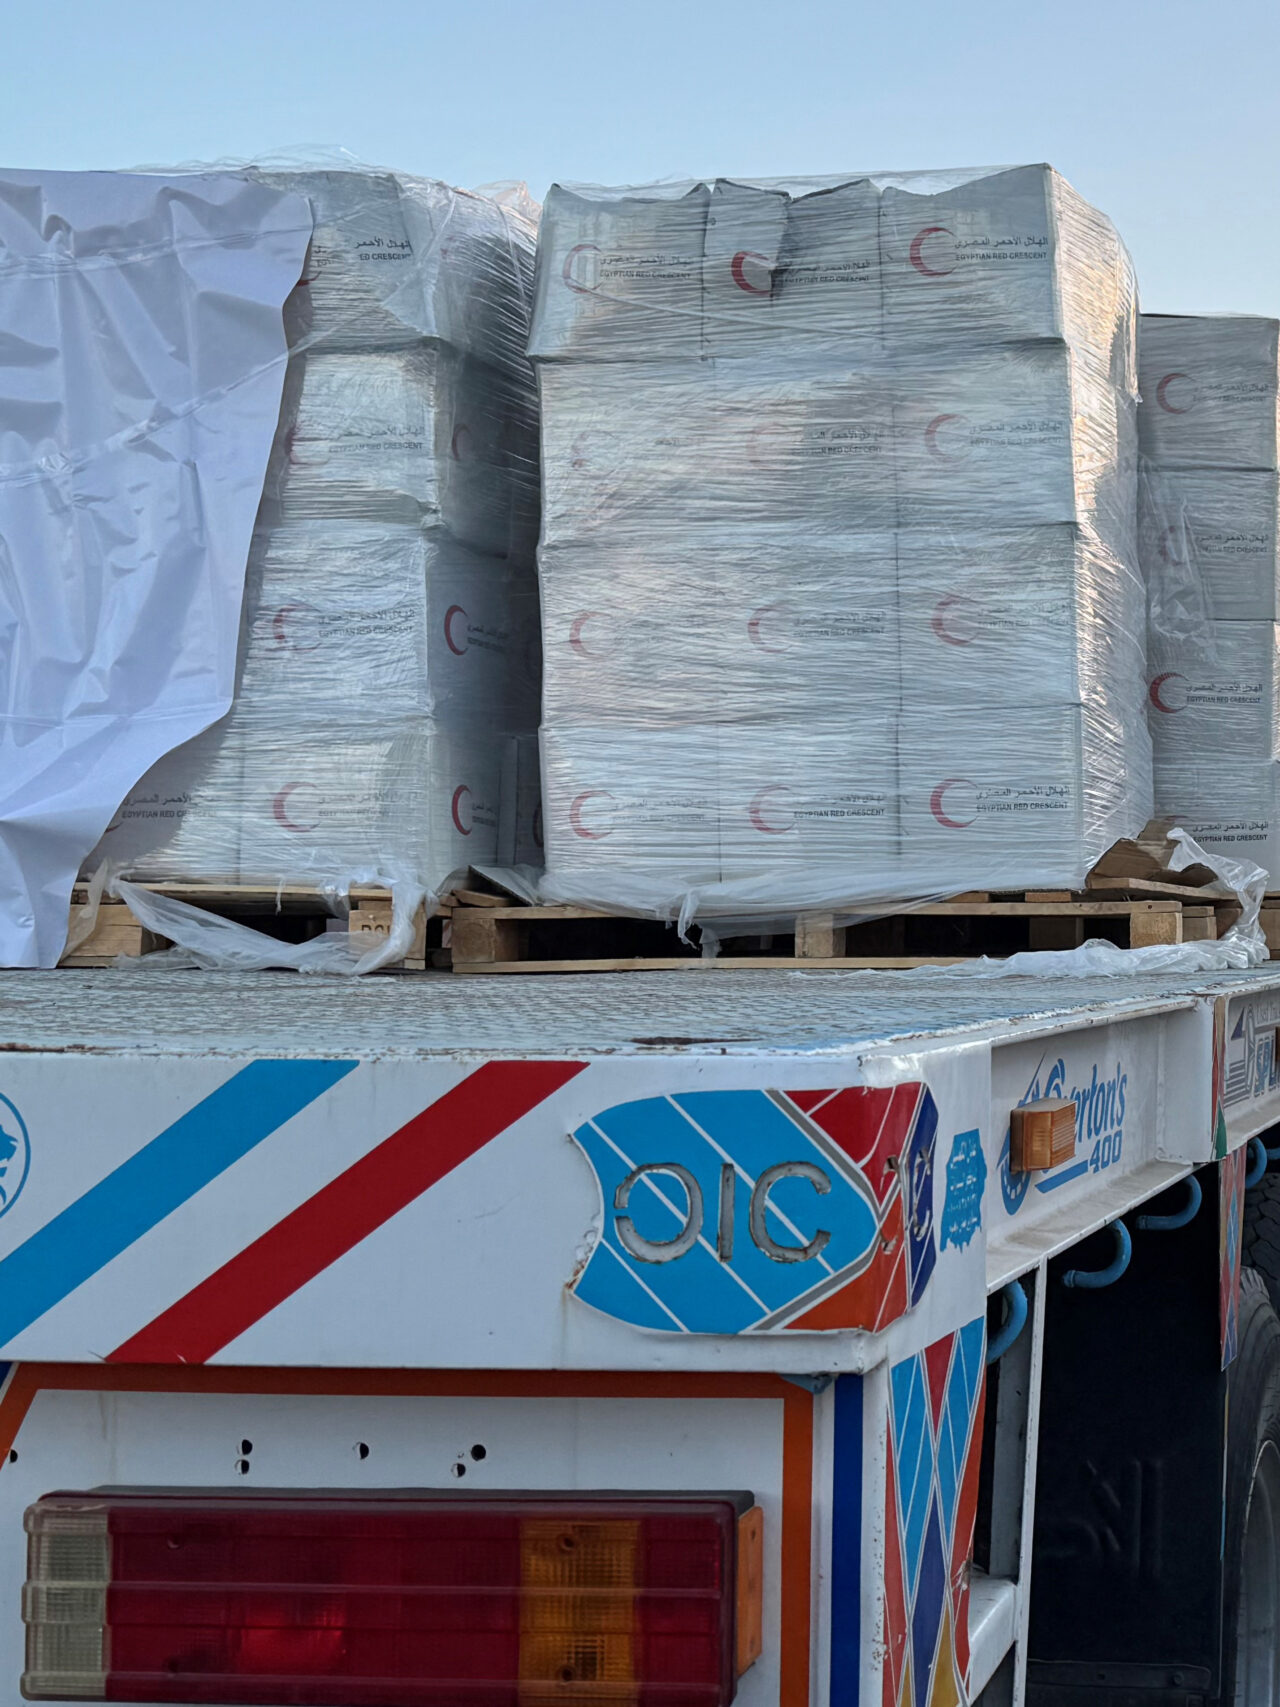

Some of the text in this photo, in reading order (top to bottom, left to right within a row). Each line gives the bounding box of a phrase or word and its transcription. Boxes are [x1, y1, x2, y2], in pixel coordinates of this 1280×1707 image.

[956, 251, 1047, 261] EGYPTIAN RED CRESCENT
[1230, 696, 1261, 704] CRESCENT
[976, 801, 1068, 812] EGYPTIAN RED CRESCENT
[847, 808, 885, 817] CRESCENT
[1089, 1129, 1123, 1174] 400
